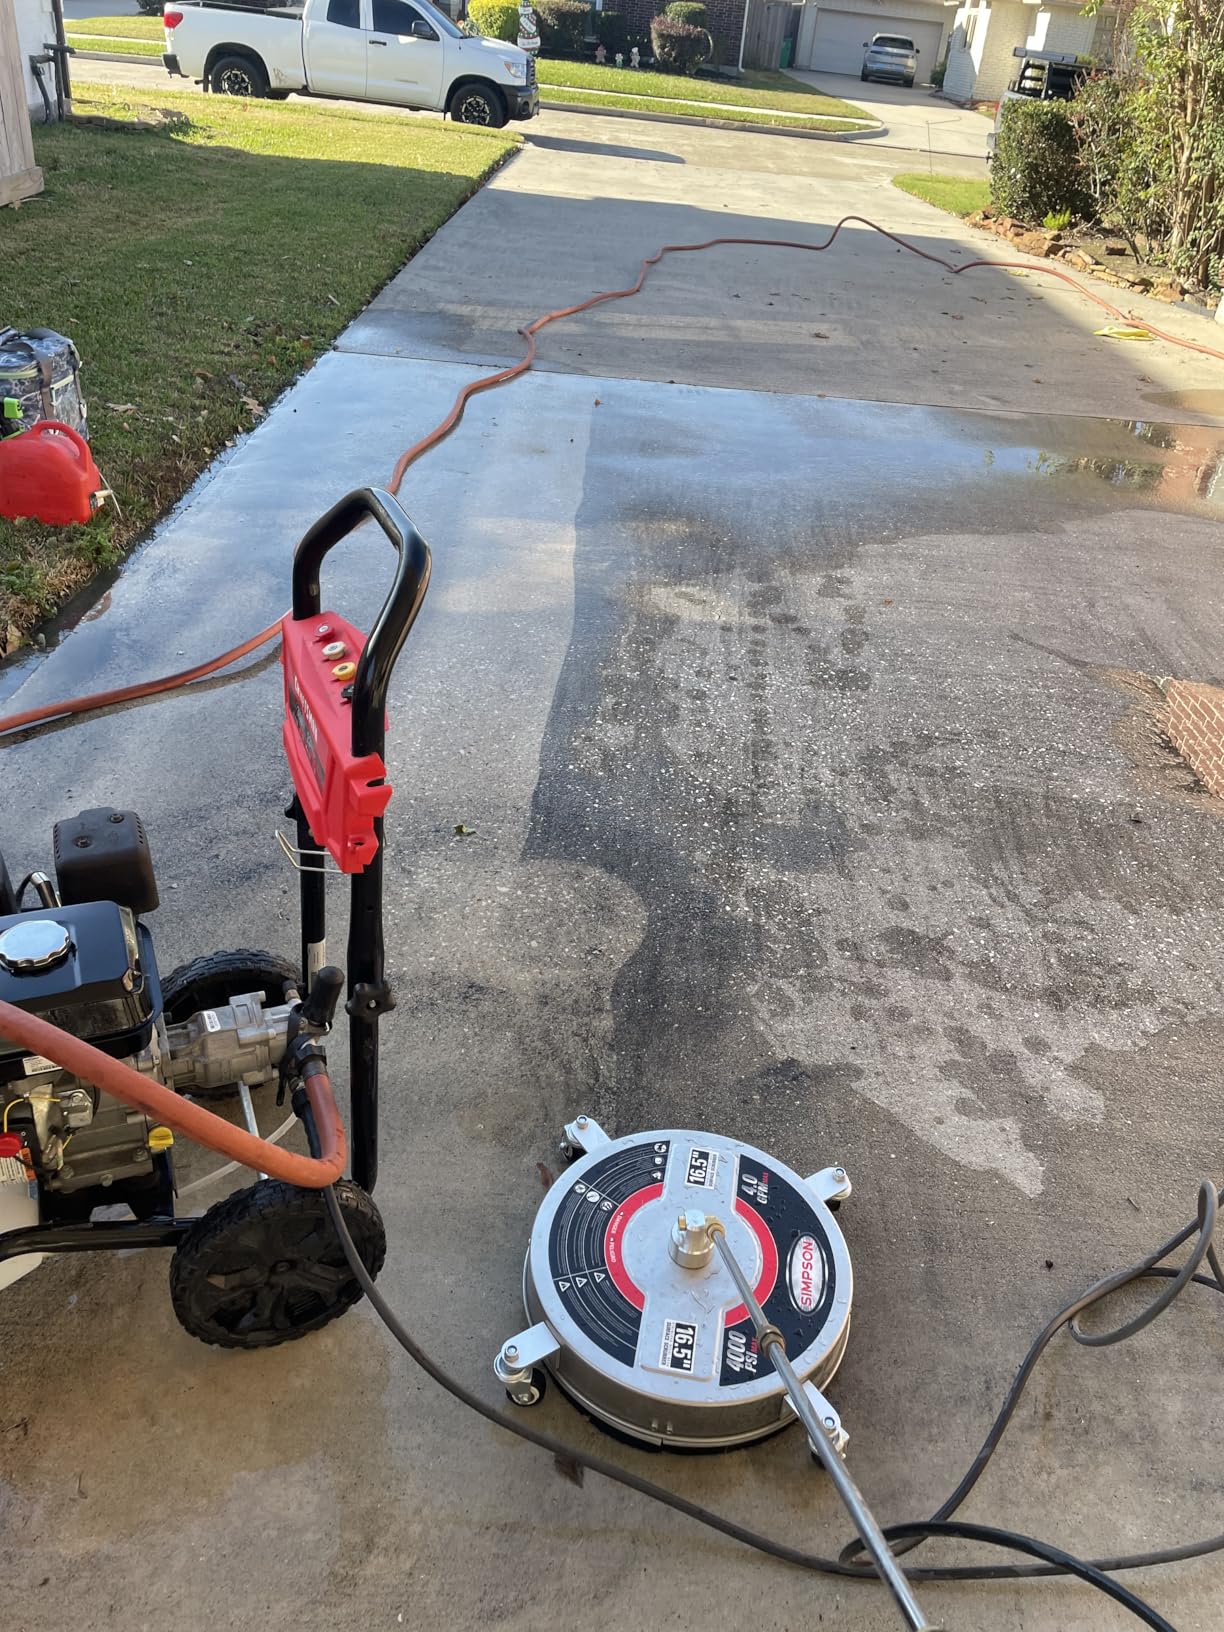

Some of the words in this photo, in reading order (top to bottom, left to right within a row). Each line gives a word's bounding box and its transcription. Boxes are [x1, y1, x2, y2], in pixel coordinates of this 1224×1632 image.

[689, 1151, 707, 1182] 16.5"
[741, 1173, 758, 1195] 4.0
[757, 1181, 768, 1204] GPM
[801, 1240, 813, 1306] SIMPSON
[673, 1327, 694, 1368] 16.5"
[726, 1330, 746, 1372] 4000
[744, 1350, 758, 1373] PSI
